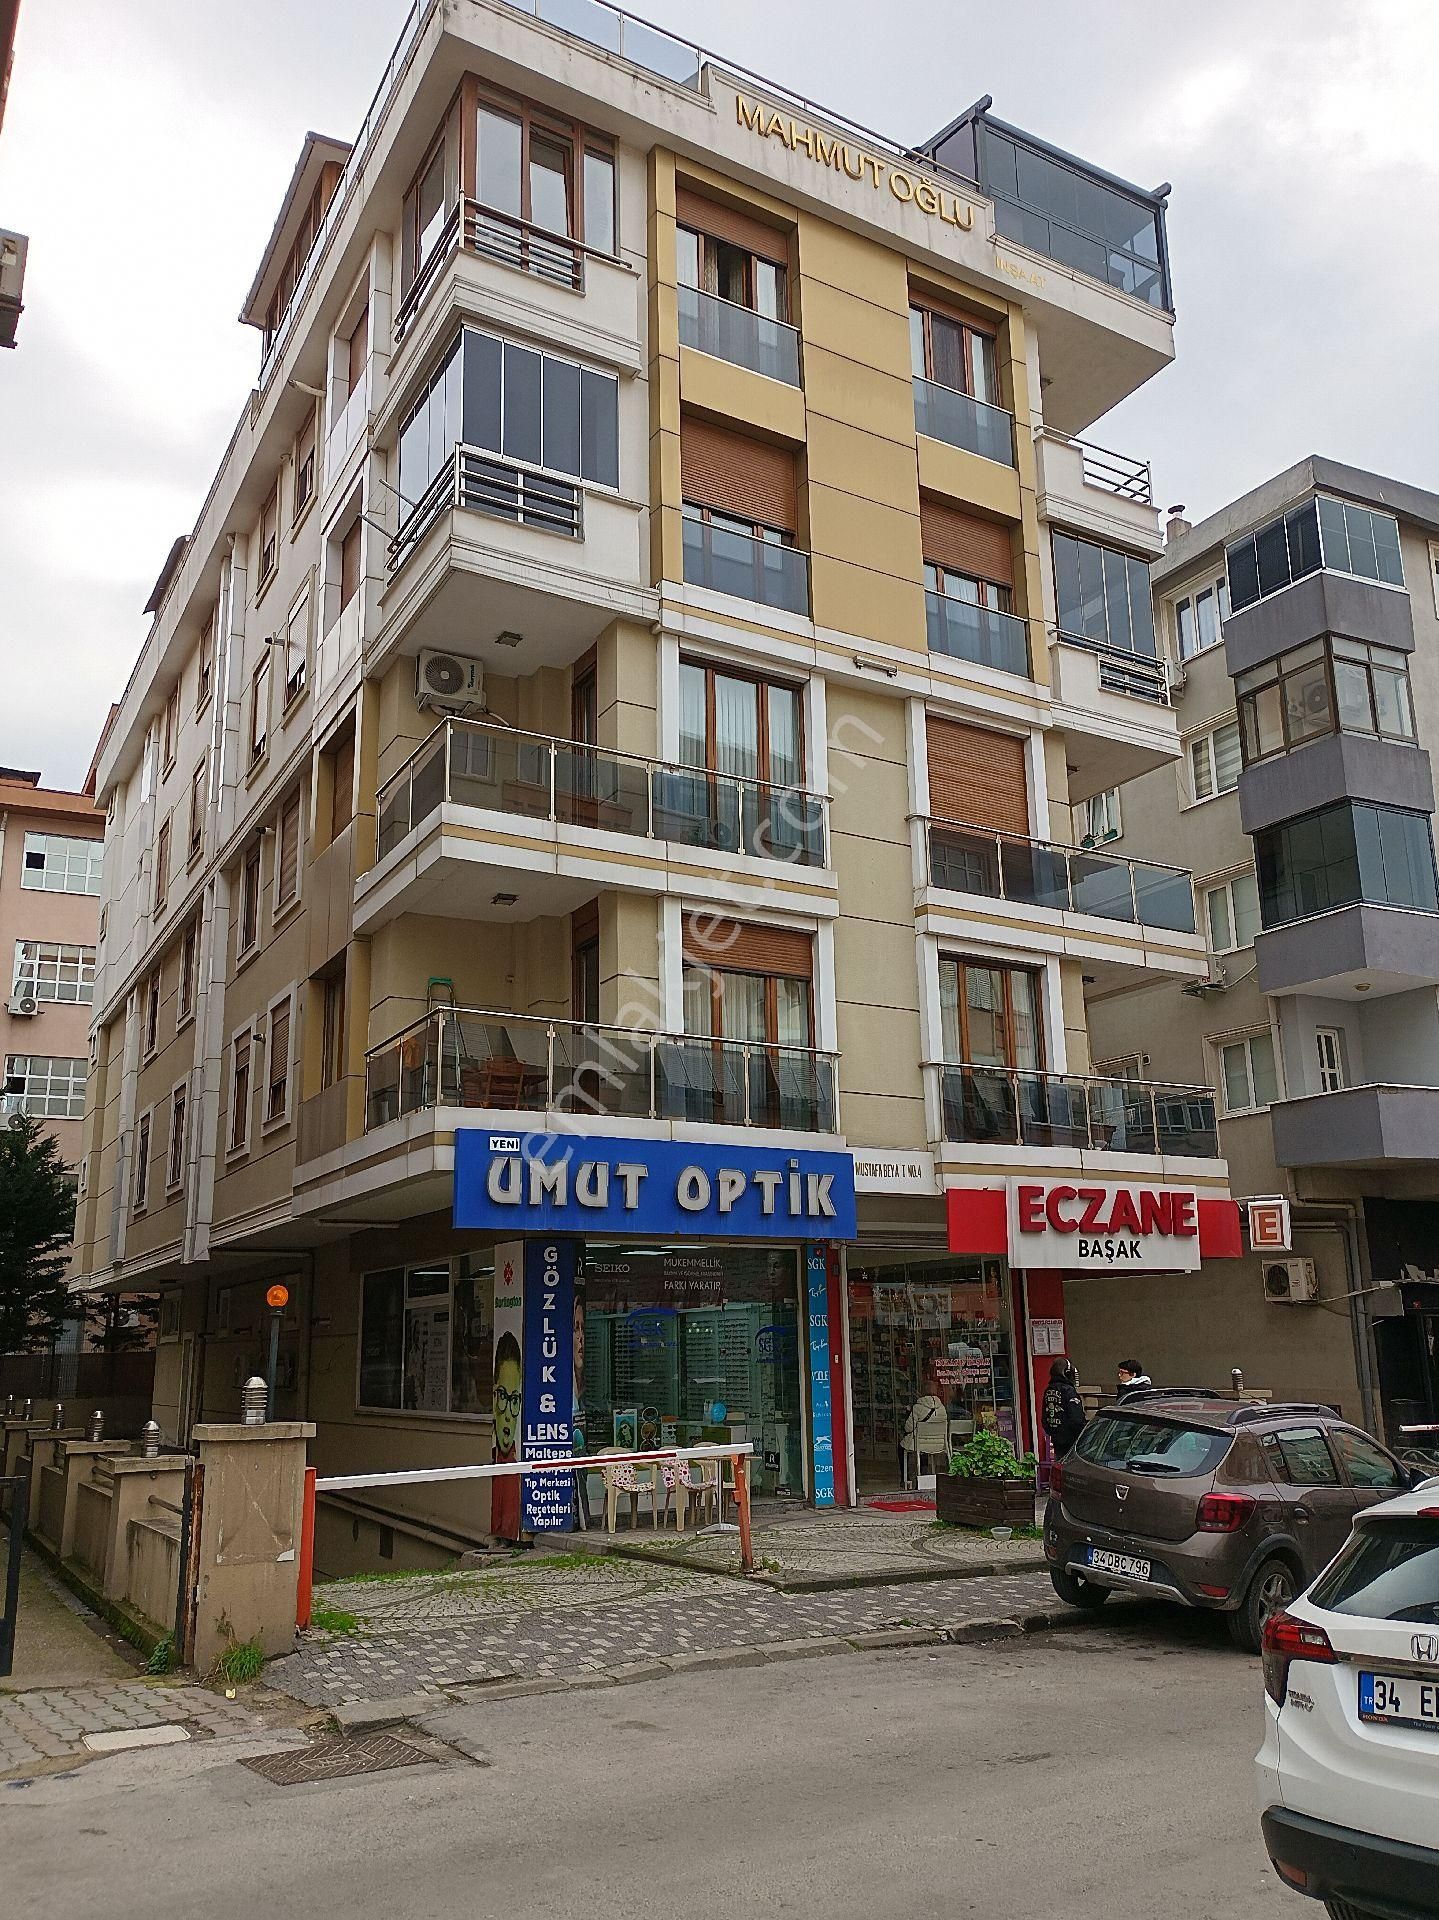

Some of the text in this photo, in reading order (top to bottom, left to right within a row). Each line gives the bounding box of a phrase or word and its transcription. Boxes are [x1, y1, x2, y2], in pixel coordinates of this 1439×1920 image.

[490, 1138, 519, 1151] YENİ
[487, 1156, 838, 1217] UMUT OPTİK
[1017, 1184, 1198, 1237] ECZANE
[1258, 1211, 1278, 1241] E
[1078, 1239, 1142, 1264] BAŞAK
[594, 1263, 631, 1273] SEIKO
[807, 1257, 826, 1270] SGK
[664, 1280, 687, 1290] FARKI
[809, 1314, 829, 1327] SGK
[540, 1246, 560, 1413] GÖZLÜK &
[527, 1423, 569, 1441] LENS
[540, 1477, 571, 1487] Merkezi
[532, 1489, 561, 1504] Optik
[815, 1487, 835, 1499] SGK
[526, 1502, 571, 1518] Reçeteleri
[1093, 1550, 1149, 1575] 34 DBC 796
[1364, 1680, 1439, 1718] TR 34 E
